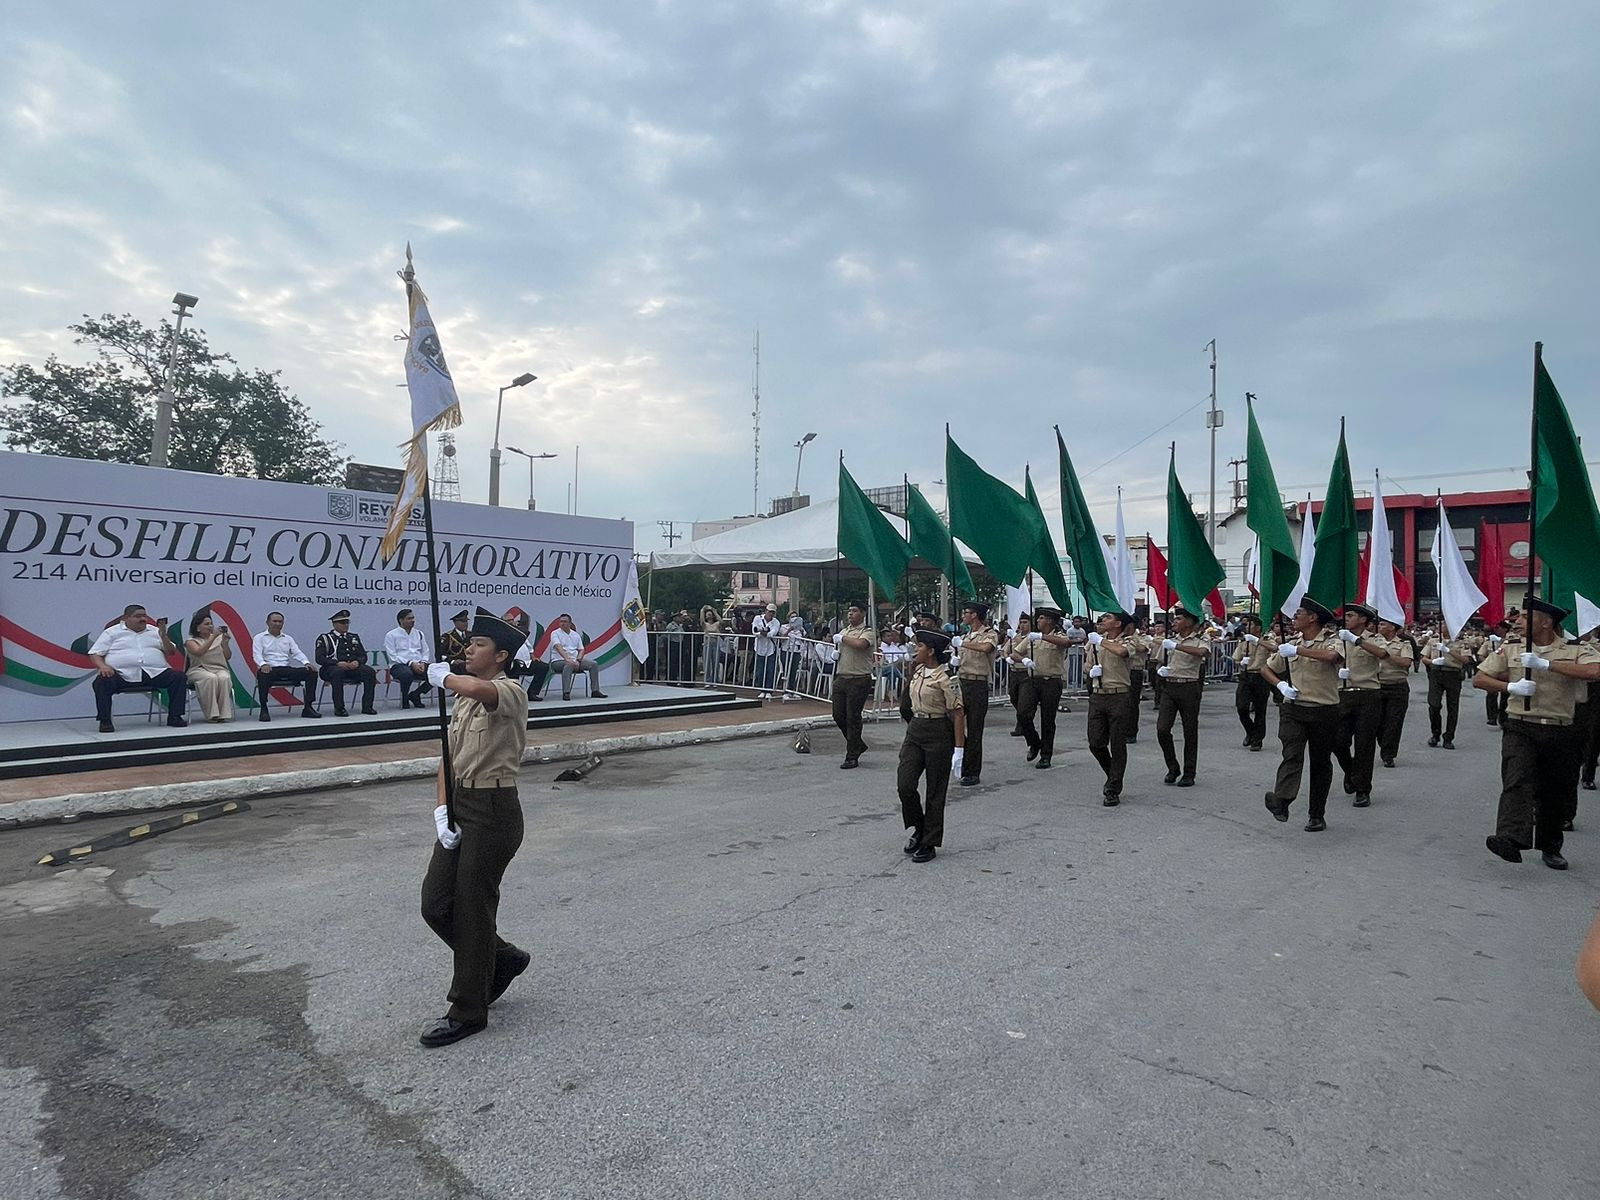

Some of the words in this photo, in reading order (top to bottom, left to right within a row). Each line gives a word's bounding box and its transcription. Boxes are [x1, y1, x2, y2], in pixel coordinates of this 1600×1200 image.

[359, 503, 426, 520] REYS
[0, 508, 256, 564] DESFILE
[266, 529, 621, 583] CONMEMORATIVO
[12, 561, 68, 580] 214
[75, 563, 206, 585] Aniversario
[213, 569, 245, 586] del
[251, 571, 300, 588] Inicio
[305, 573, 328, 589] de
[333, 574, 349, 590] la
[354, 575, 403, 591] Lucha
[438, 578, 451, 593] la
[456, 580, 551, 597] Independencia
[555, 584, 570, 597] de
[573, 584, 612, 598] México
[273, 594, 314, 605] Reynosa,
[315, 595, 366, 605] Tamaulipas,
[374, 597, 386, 605] 16
[387, 597, 398, 605] de
